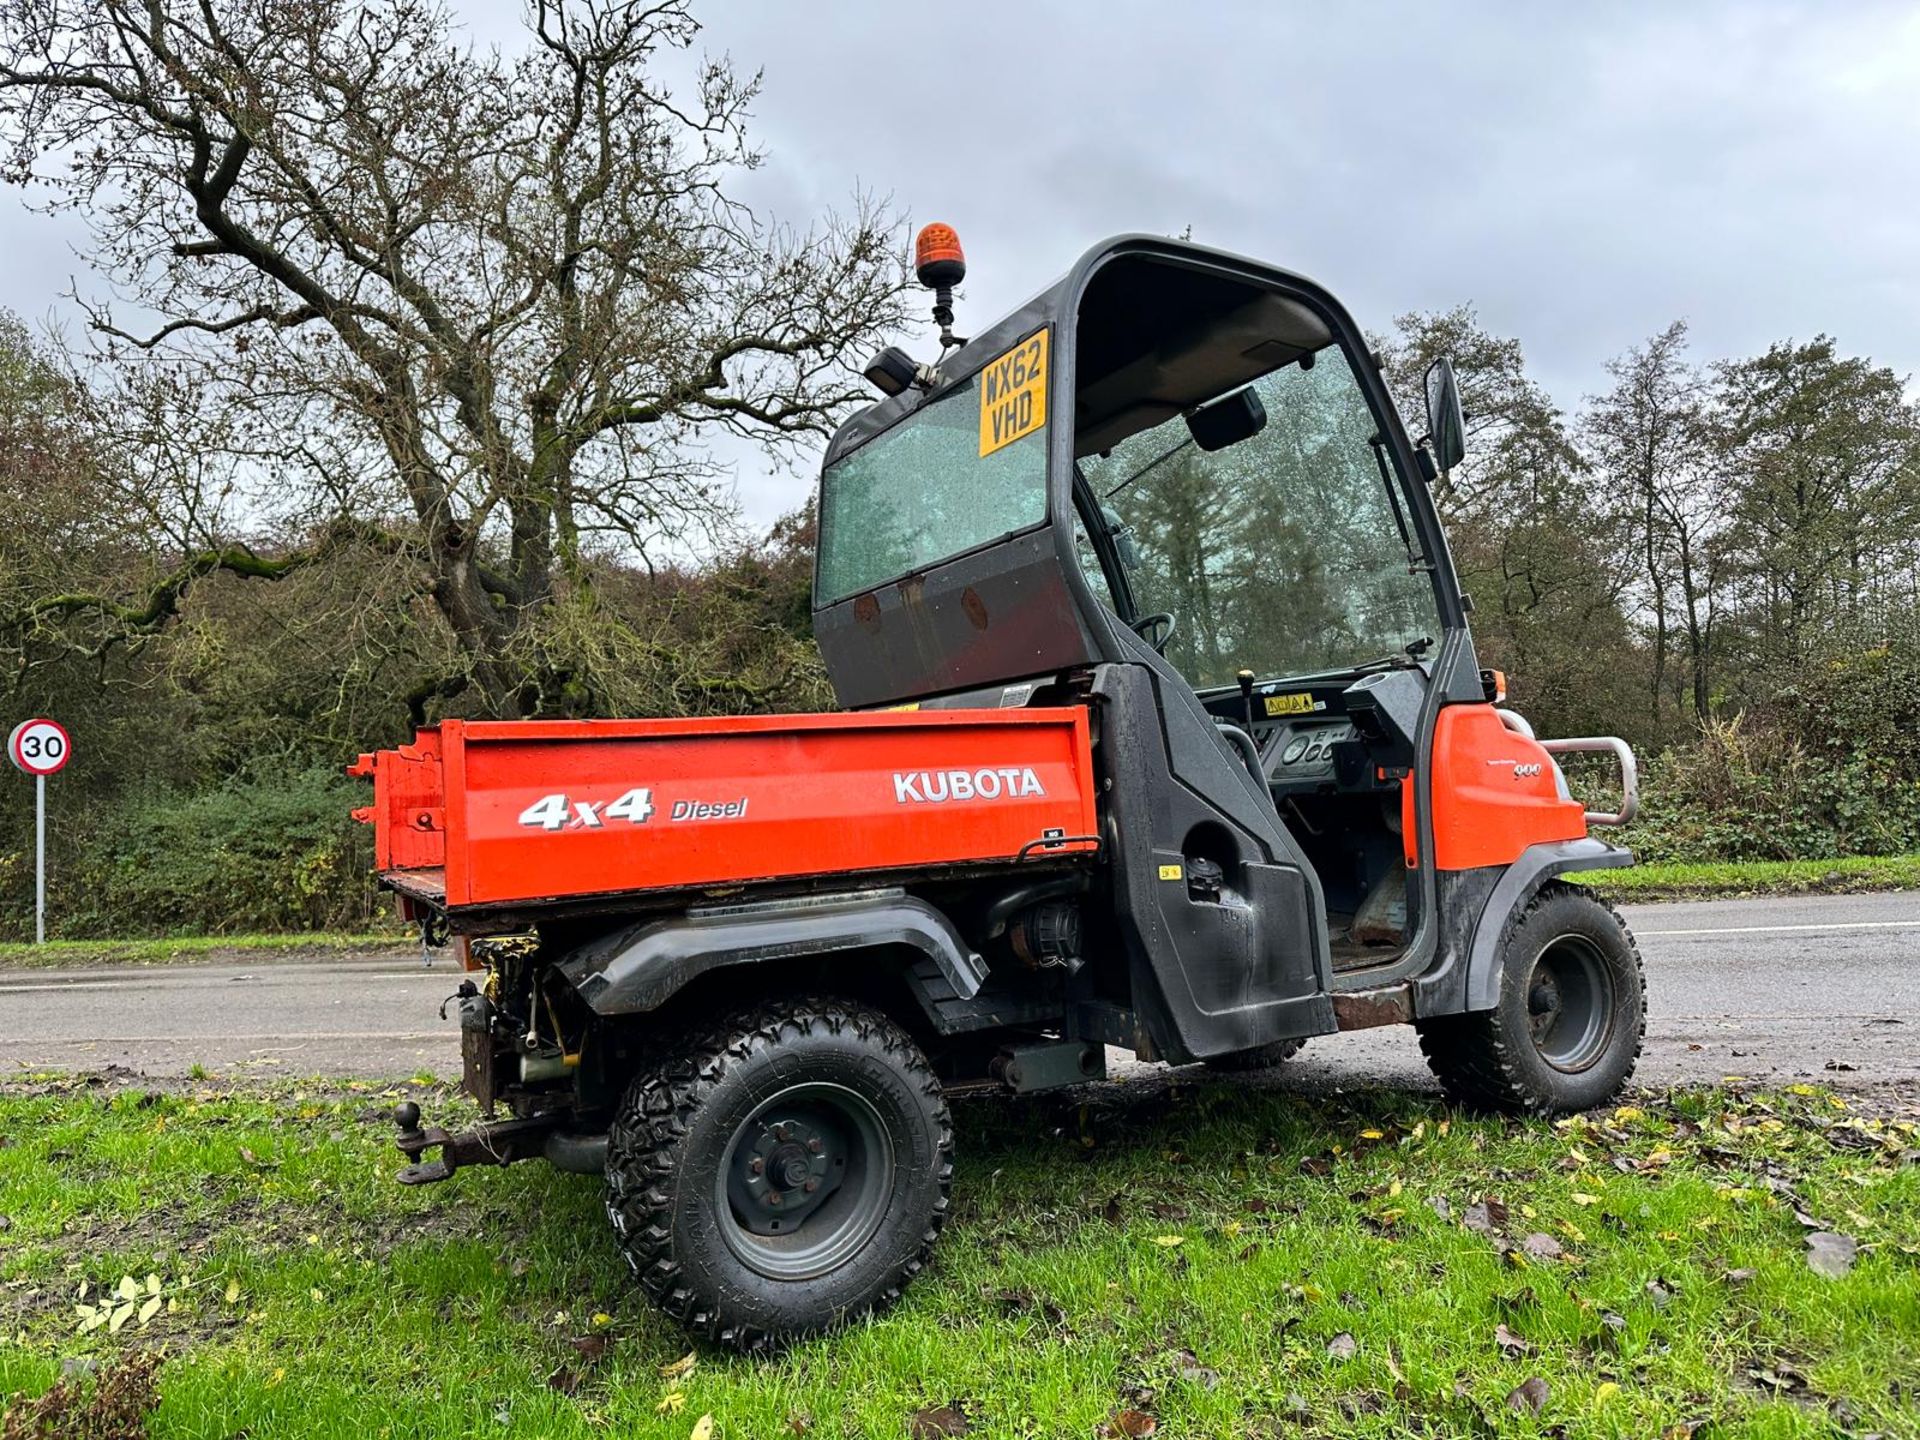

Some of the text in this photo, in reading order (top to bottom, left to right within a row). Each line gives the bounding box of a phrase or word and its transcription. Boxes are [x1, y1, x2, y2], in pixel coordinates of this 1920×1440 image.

[987, 340, 1040, 406] WX62
[992, 390, 1032, 444] VHD
[24, 735, 63, 758] 30
[892, 767, 1046, 804] KUBOTA
[518, 788, 749, 831] 4x4 Diesel
